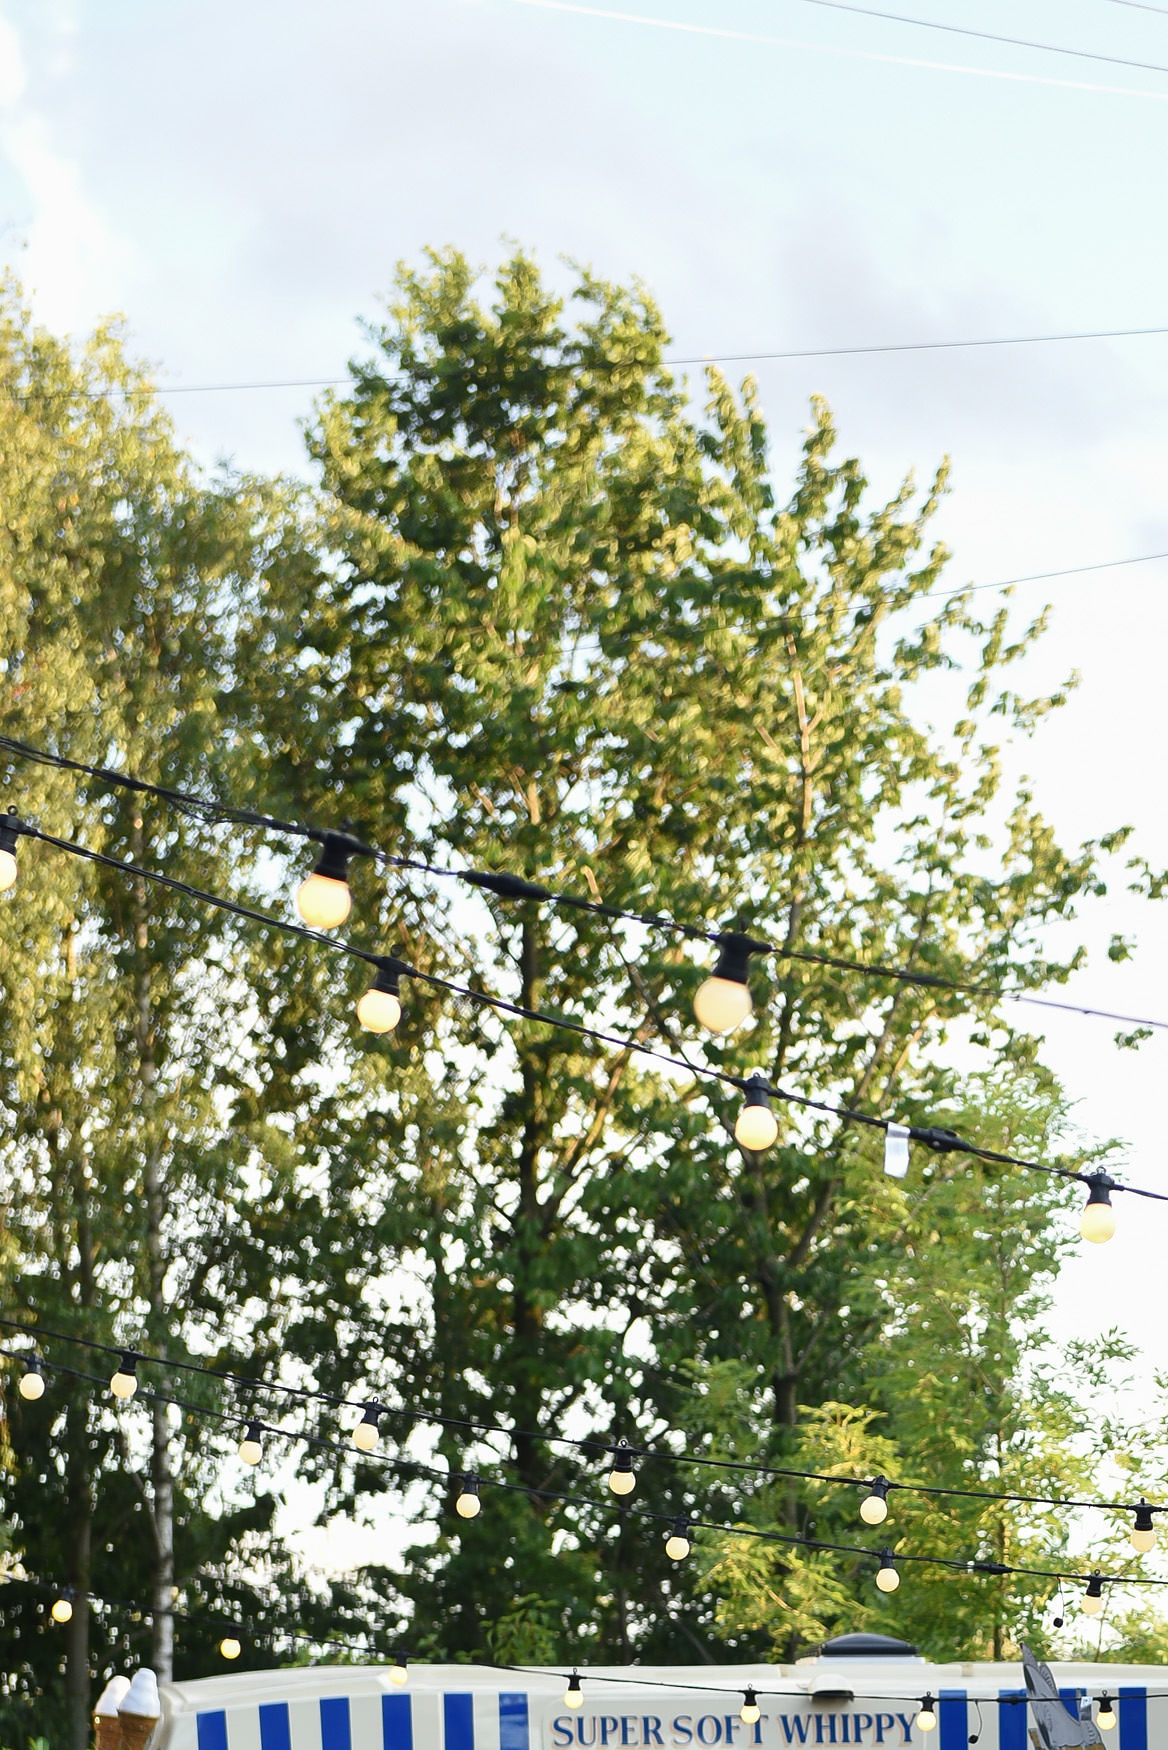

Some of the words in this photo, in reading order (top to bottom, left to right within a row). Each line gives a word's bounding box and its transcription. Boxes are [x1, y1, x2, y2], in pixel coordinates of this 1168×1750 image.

[551, 1715, 665, 1750] SUPER
[670, 1713, 769, 1749] SOFT
[779, 1712, 917, 1748] WHIPPY
